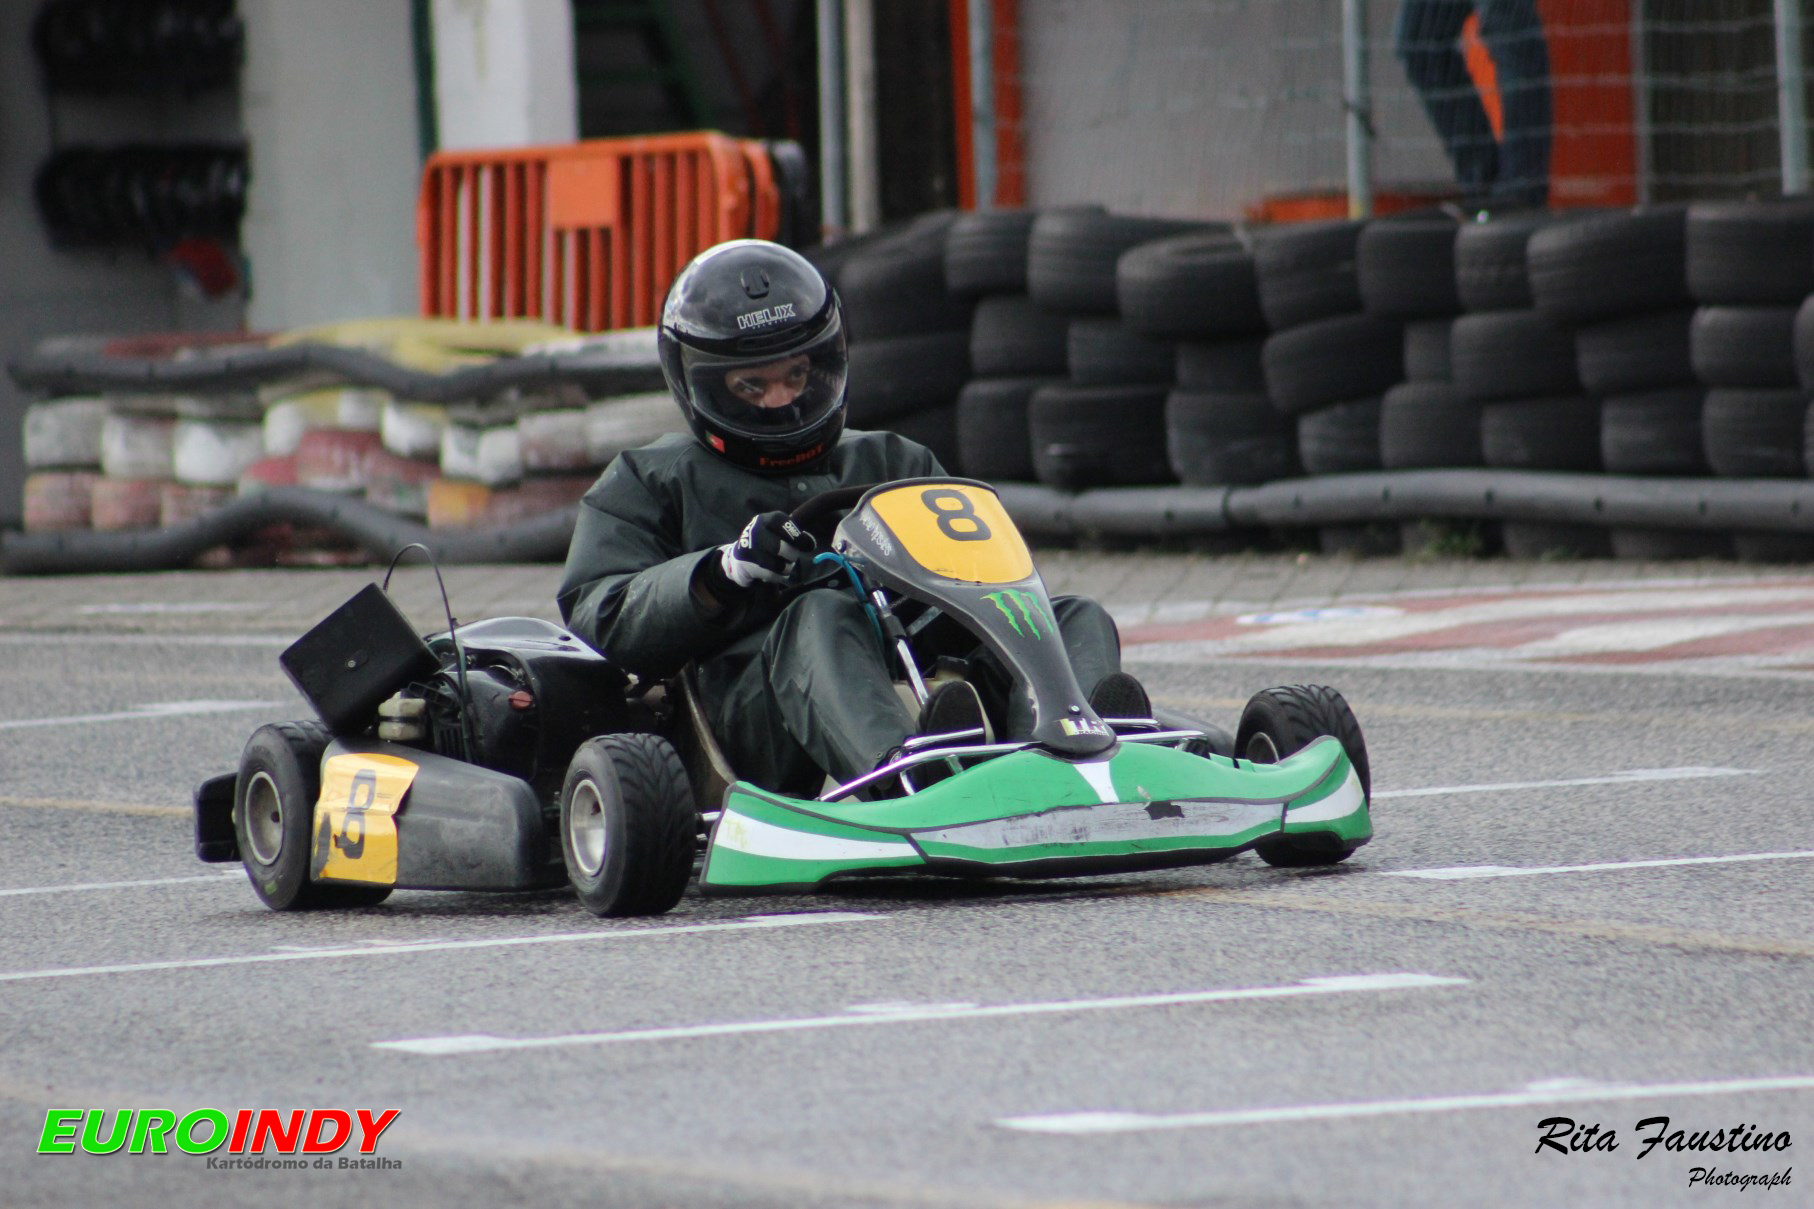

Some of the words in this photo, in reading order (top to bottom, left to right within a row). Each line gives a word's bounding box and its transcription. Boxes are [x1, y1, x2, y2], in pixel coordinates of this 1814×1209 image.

[736, 303, 796, 329] HELIX
[920, 489, 992, 542] 8
[341, 768, 377, 859] 8
